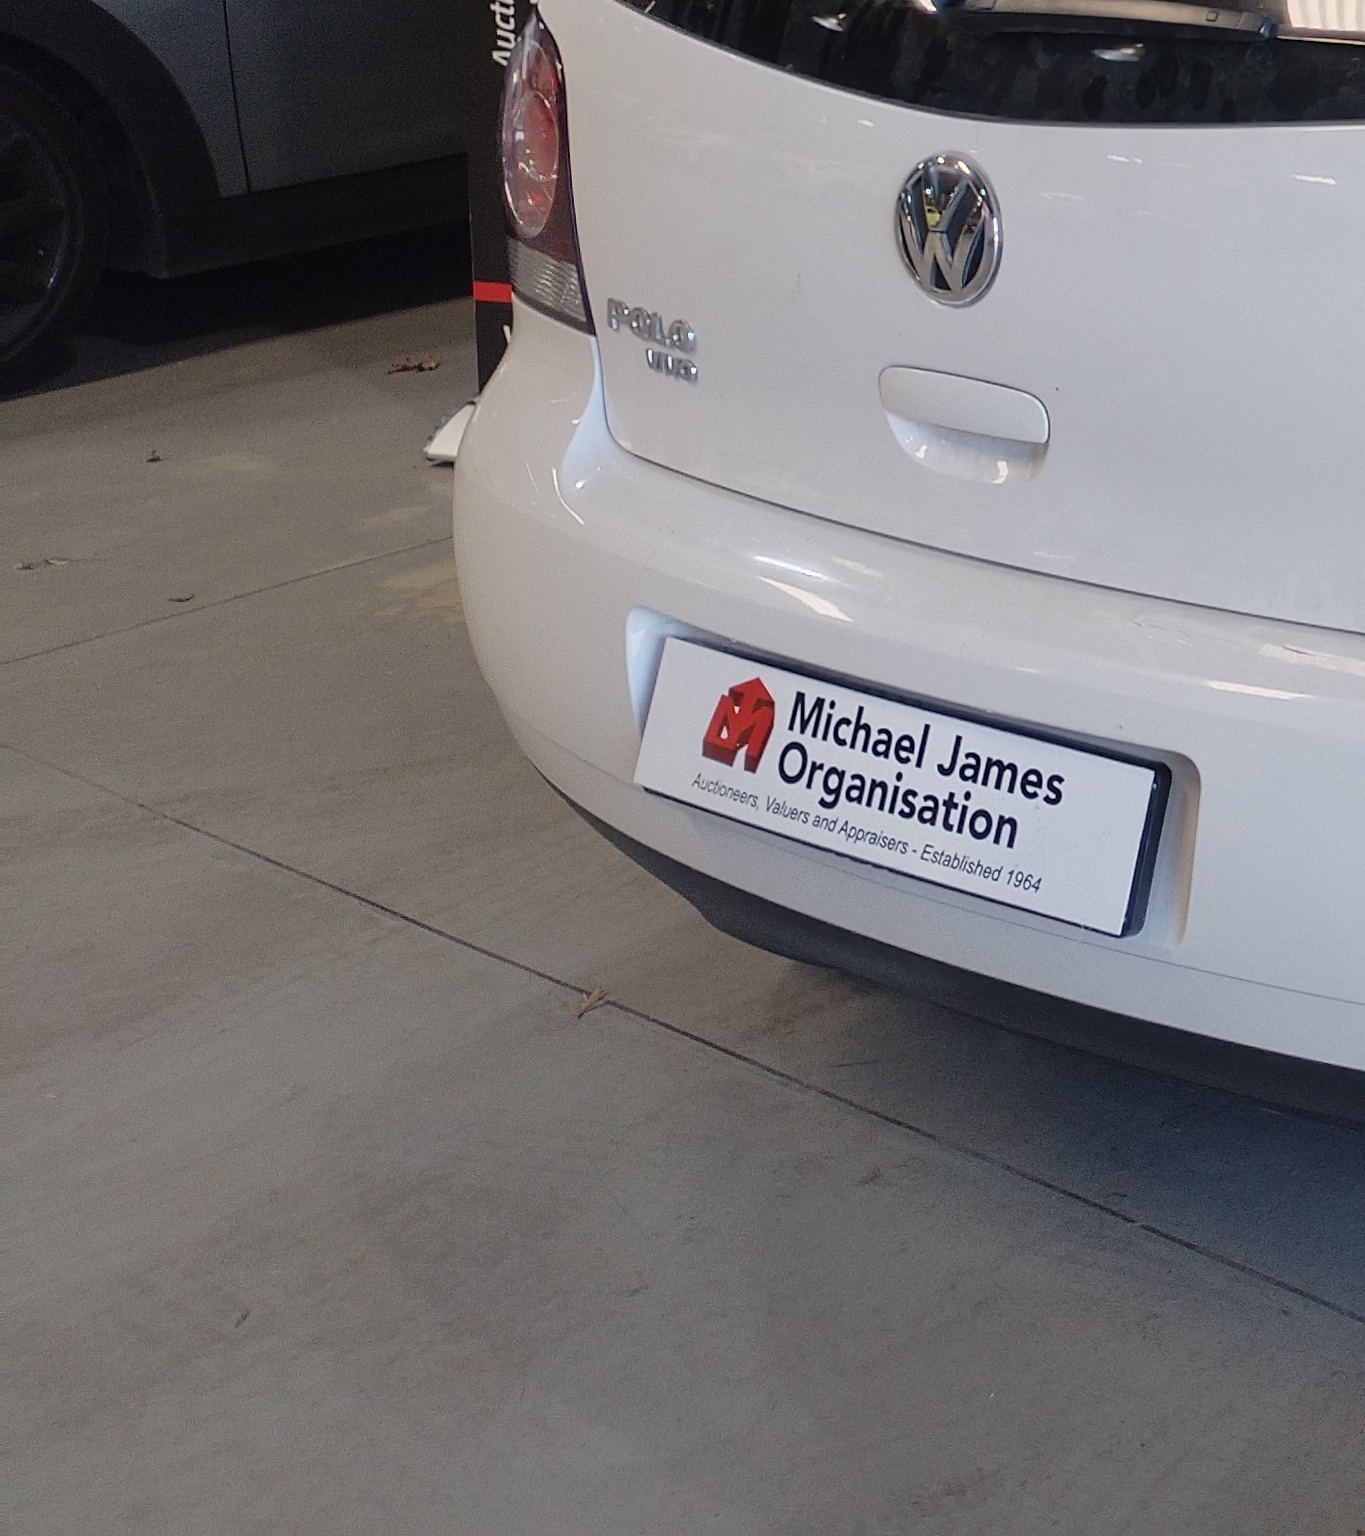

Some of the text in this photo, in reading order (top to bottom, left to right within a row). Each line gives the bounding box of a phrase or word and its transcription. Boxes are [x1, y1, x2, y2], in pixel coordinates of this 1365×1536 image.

[607, 297, 698, 354] POLO
[778, 740, 1018, 849] Organisation
[787, 690, 1066, 806] Michael James
[691, 772, 760, 811] Auctioneers,
[765, 794, 810, 825] Valuers
[812, 813, 838, 833] and
[837, 819, 910, 856] Appraisers
[919, 842, 1003, 882] Established
[1006, 868, 1043, 894] 1964
